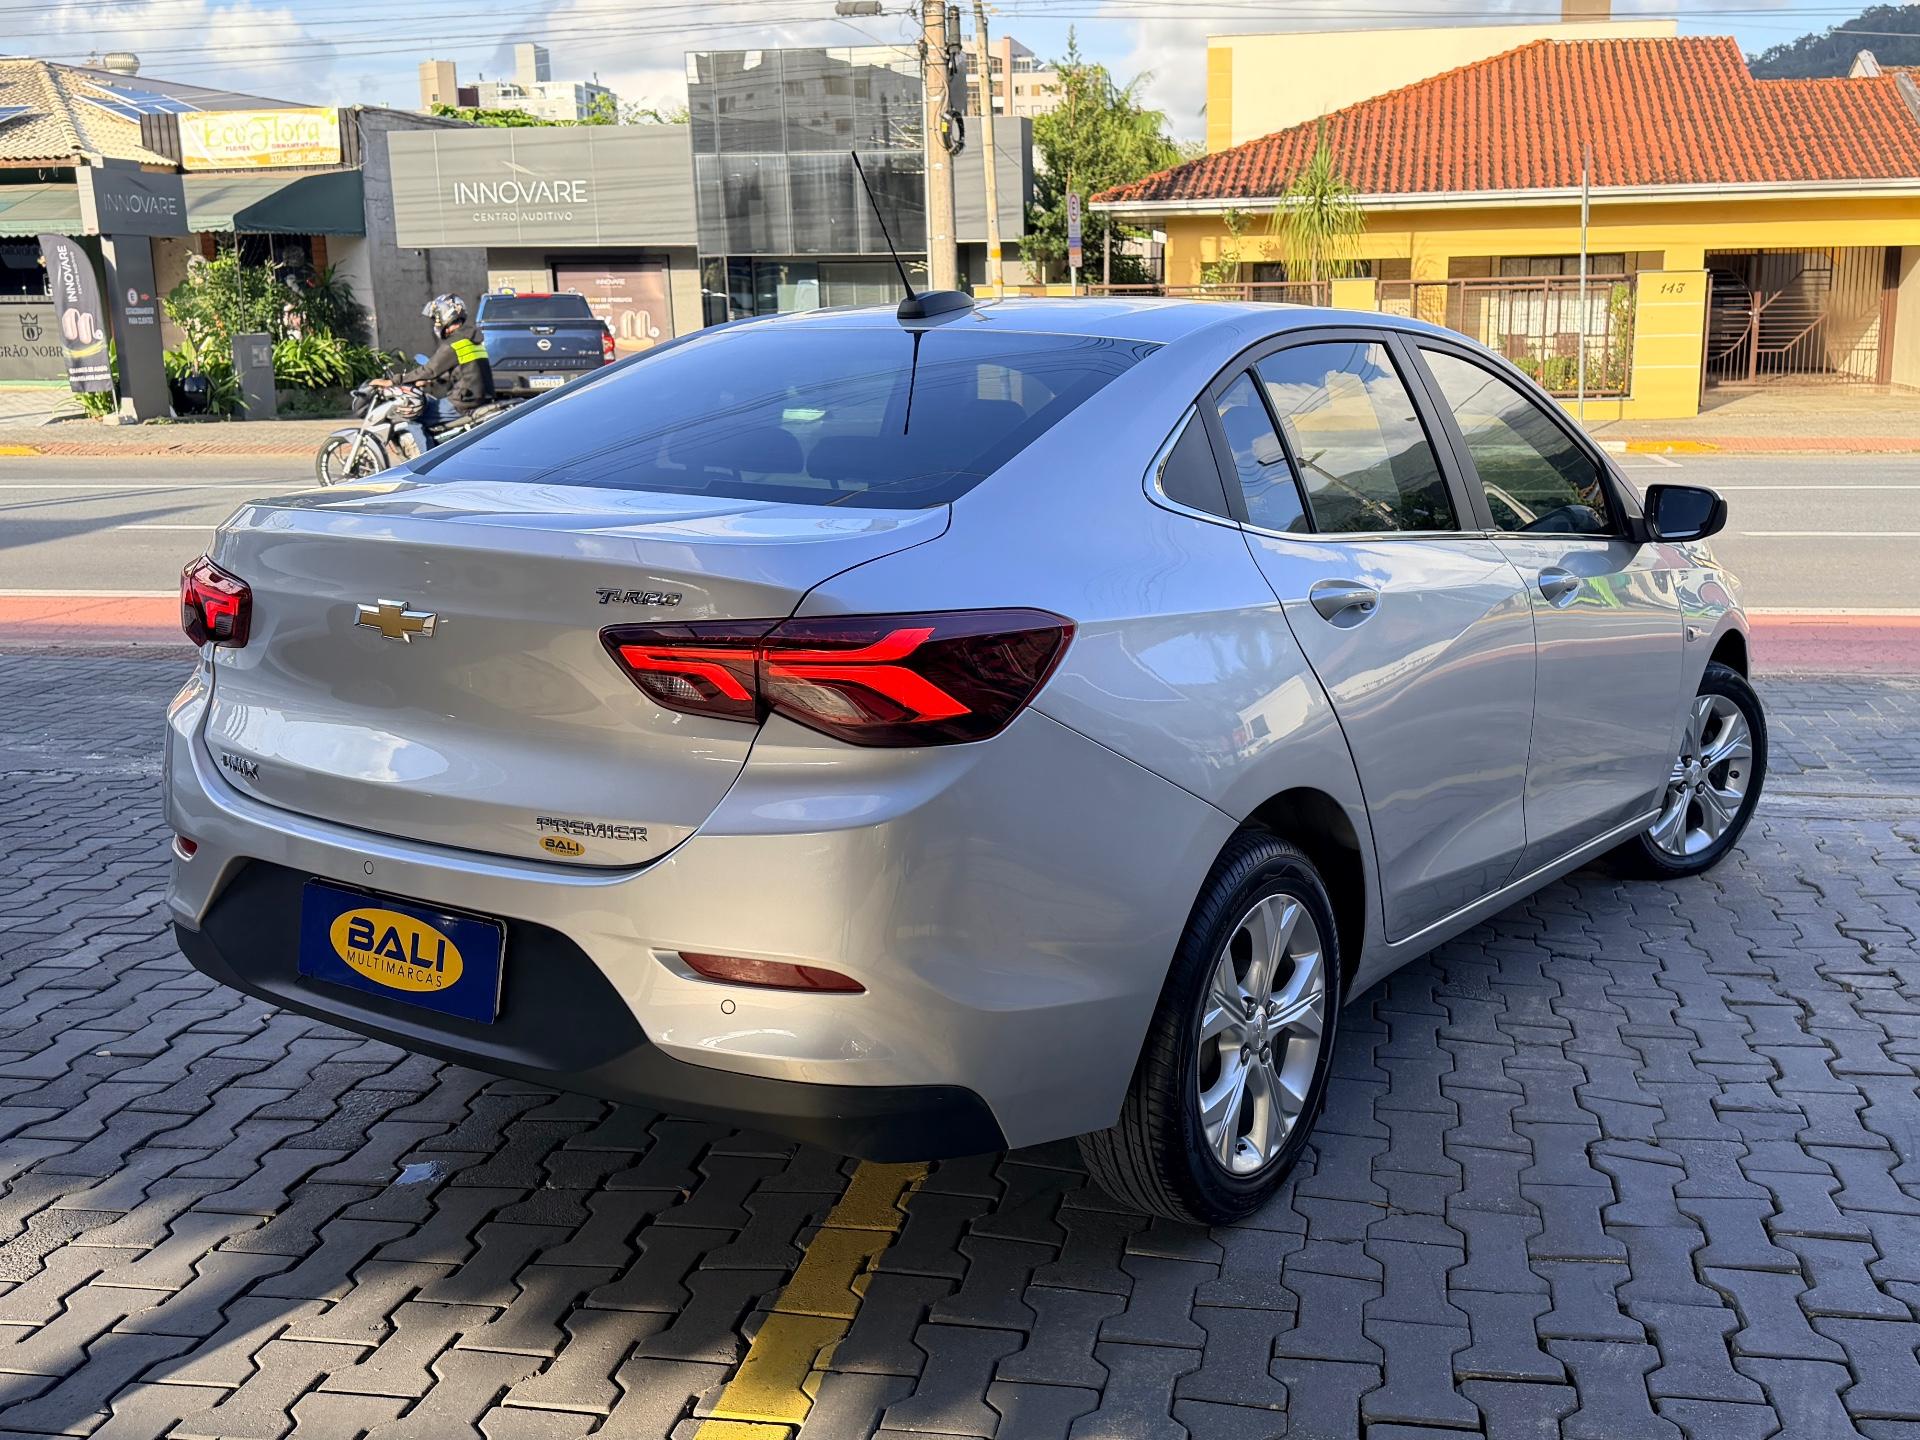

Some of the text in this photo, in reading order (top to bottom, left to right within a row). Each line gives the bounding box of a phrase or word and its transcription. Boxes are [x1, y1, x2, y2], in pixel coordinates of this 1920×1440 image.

[103, 192, 178, 216] INNOVARE
[454, 180, 588, 205] INNOVARE
[472, 211, 573, 222] CENTRO AUDITIVO
[57, 244, 78, 303] INNOVARE
[1660, 283, 1686, 294] 143
[536, 815, 648, 841] PREMIER
[545, 838, 579, 852] BALI
[348, 916, 446, 973] BALI
[346, 950, 442, 988] MULTIMARCAS
